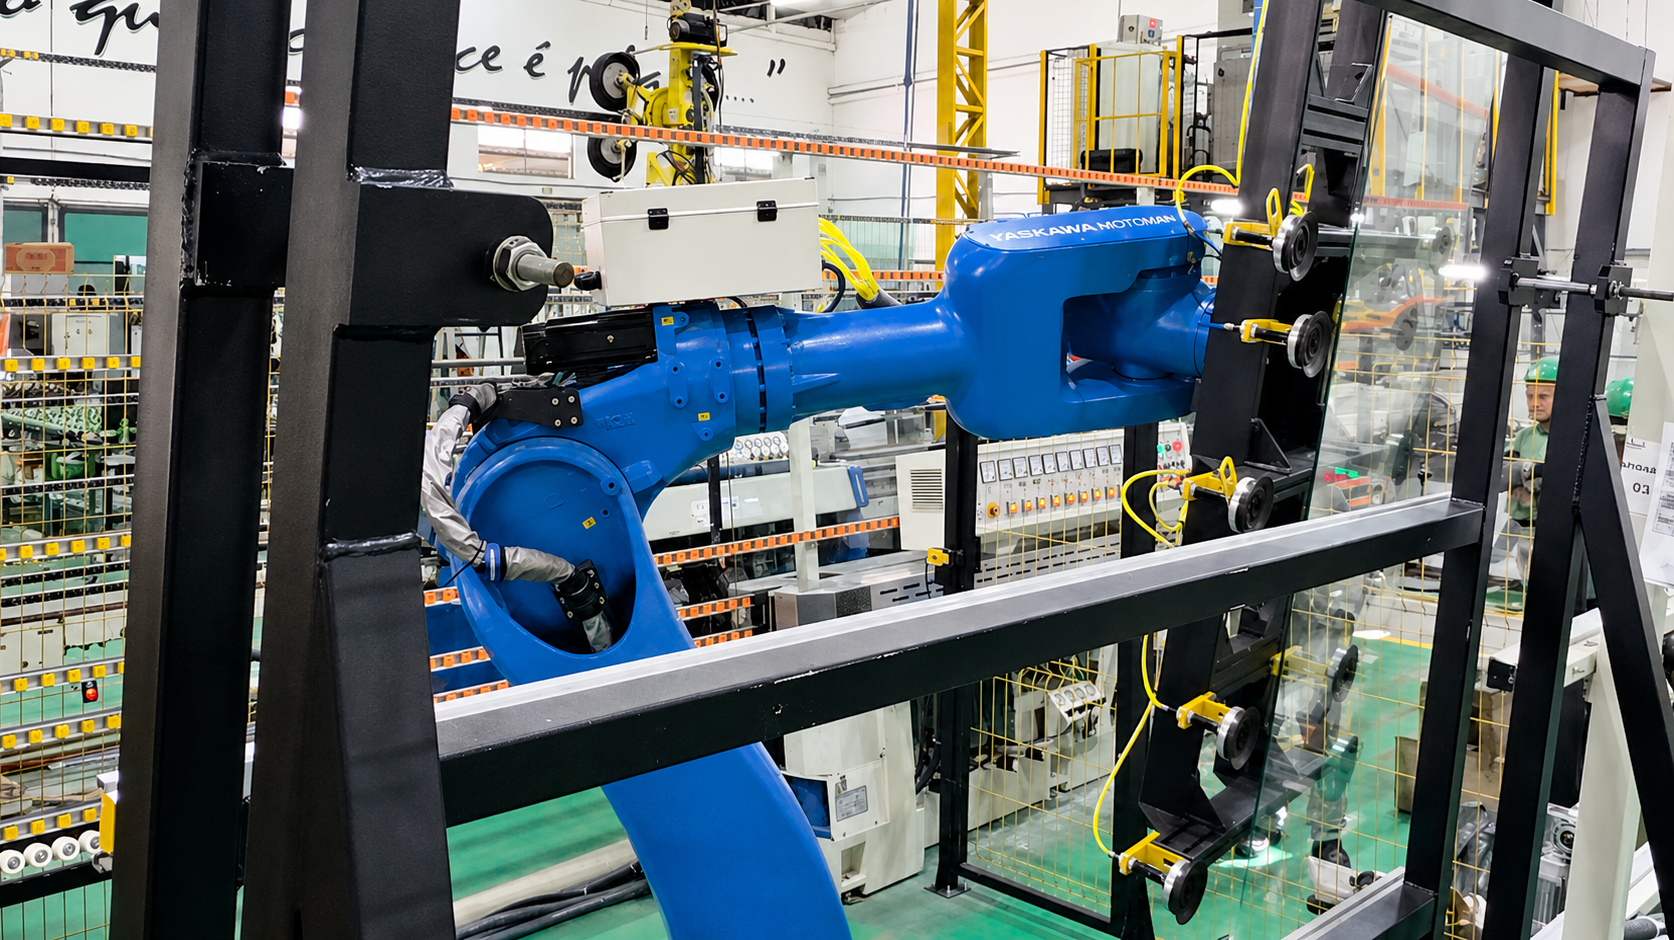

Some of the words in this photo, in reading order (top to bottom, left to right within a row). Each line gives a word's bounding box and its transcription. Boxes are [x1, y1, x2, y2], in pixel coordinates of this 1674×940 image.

[69, 0, 160, 56] qu
[455, 44, 502, 72] ce
[990, 223, 1097, 242] YASKAWA
[1099, 215, 1176, 230] MOTOMAN
